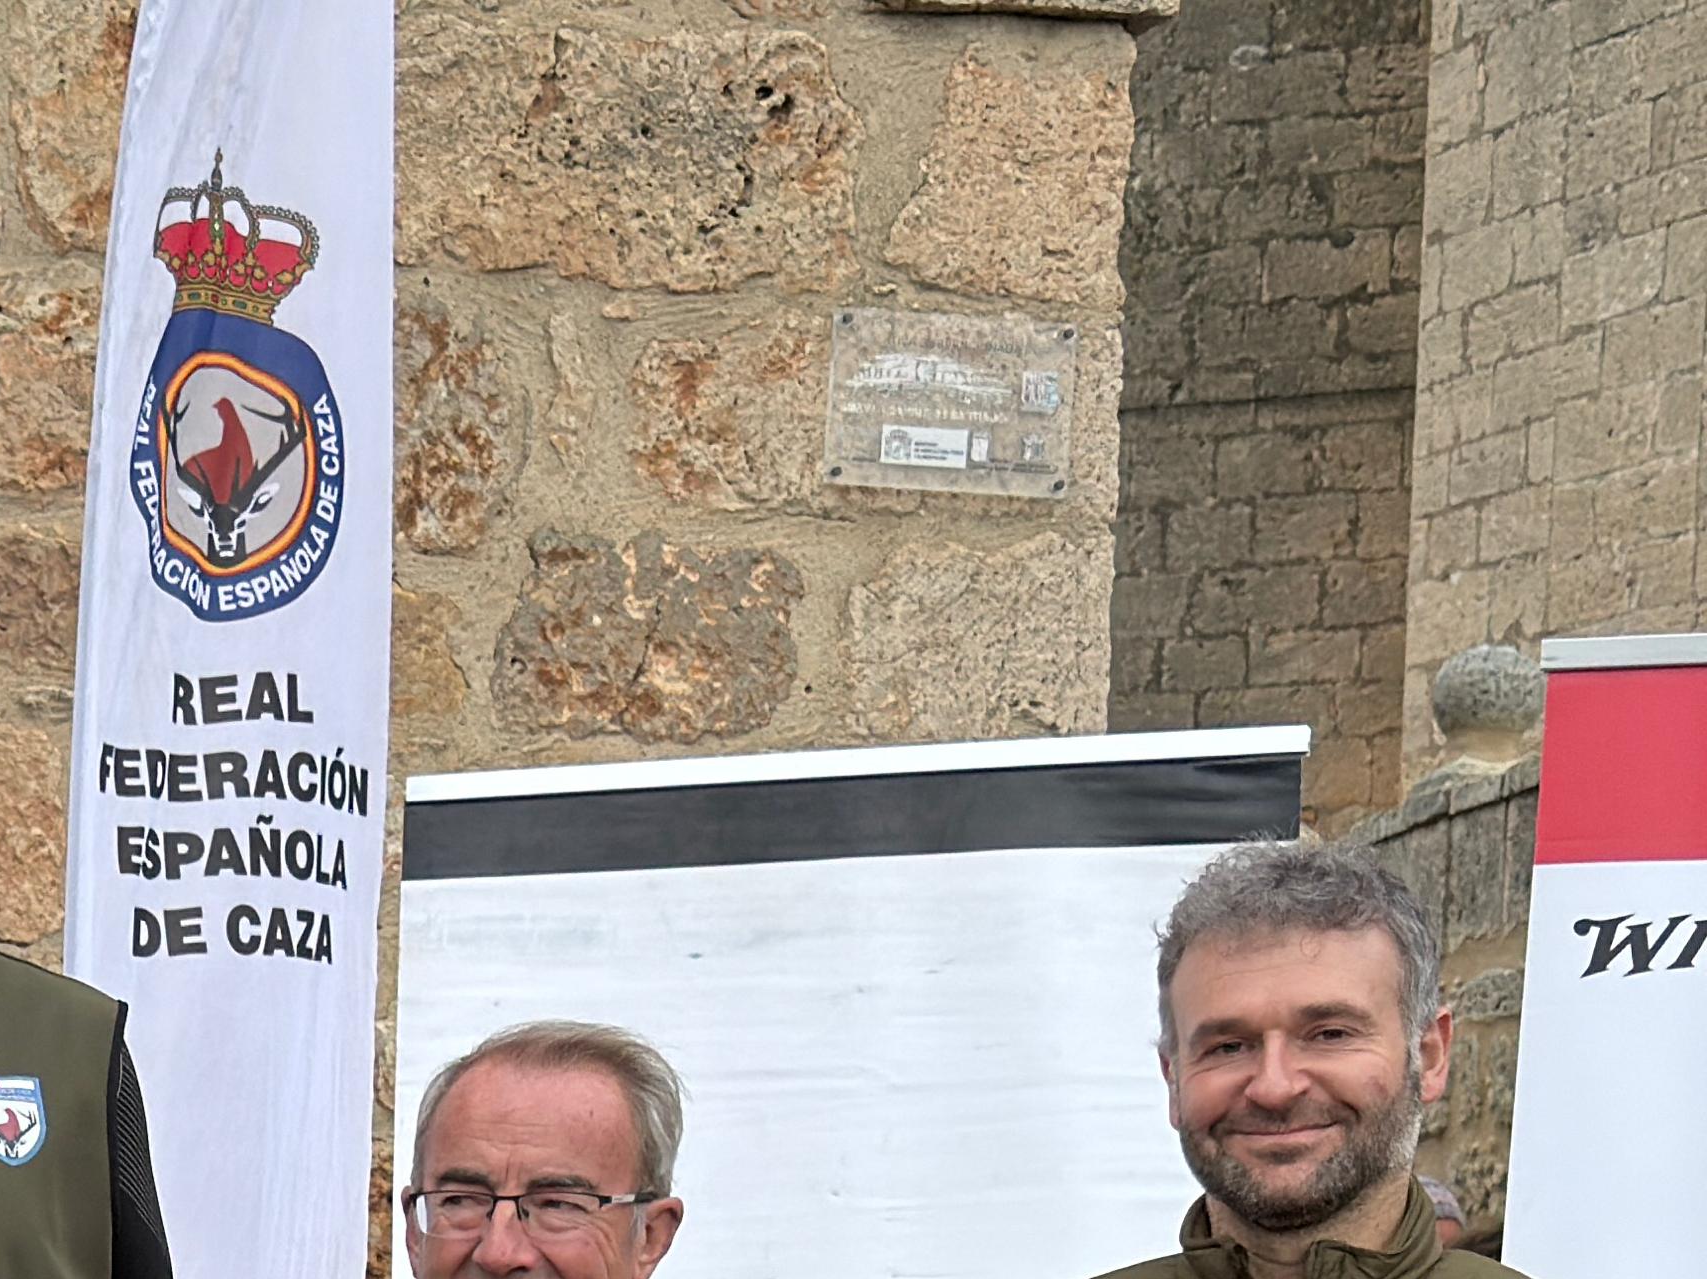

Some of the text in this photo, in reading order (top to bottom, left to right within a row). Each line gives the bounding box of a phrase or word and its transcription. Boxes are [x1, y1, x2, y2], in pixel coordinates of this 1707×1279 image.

[313, 393, 339, 473] CAZA
[322, 483, 339, 524] DE
[218, 521, 330, 612] ESPAÑOLA
[172, 671, 314, 725] REAL
[99, 742, 368, 817] FEDERACIÓN
[117, 814, 347, 891] ESPAÑOLA
[132, 904, 332, 965] DE CAZA
